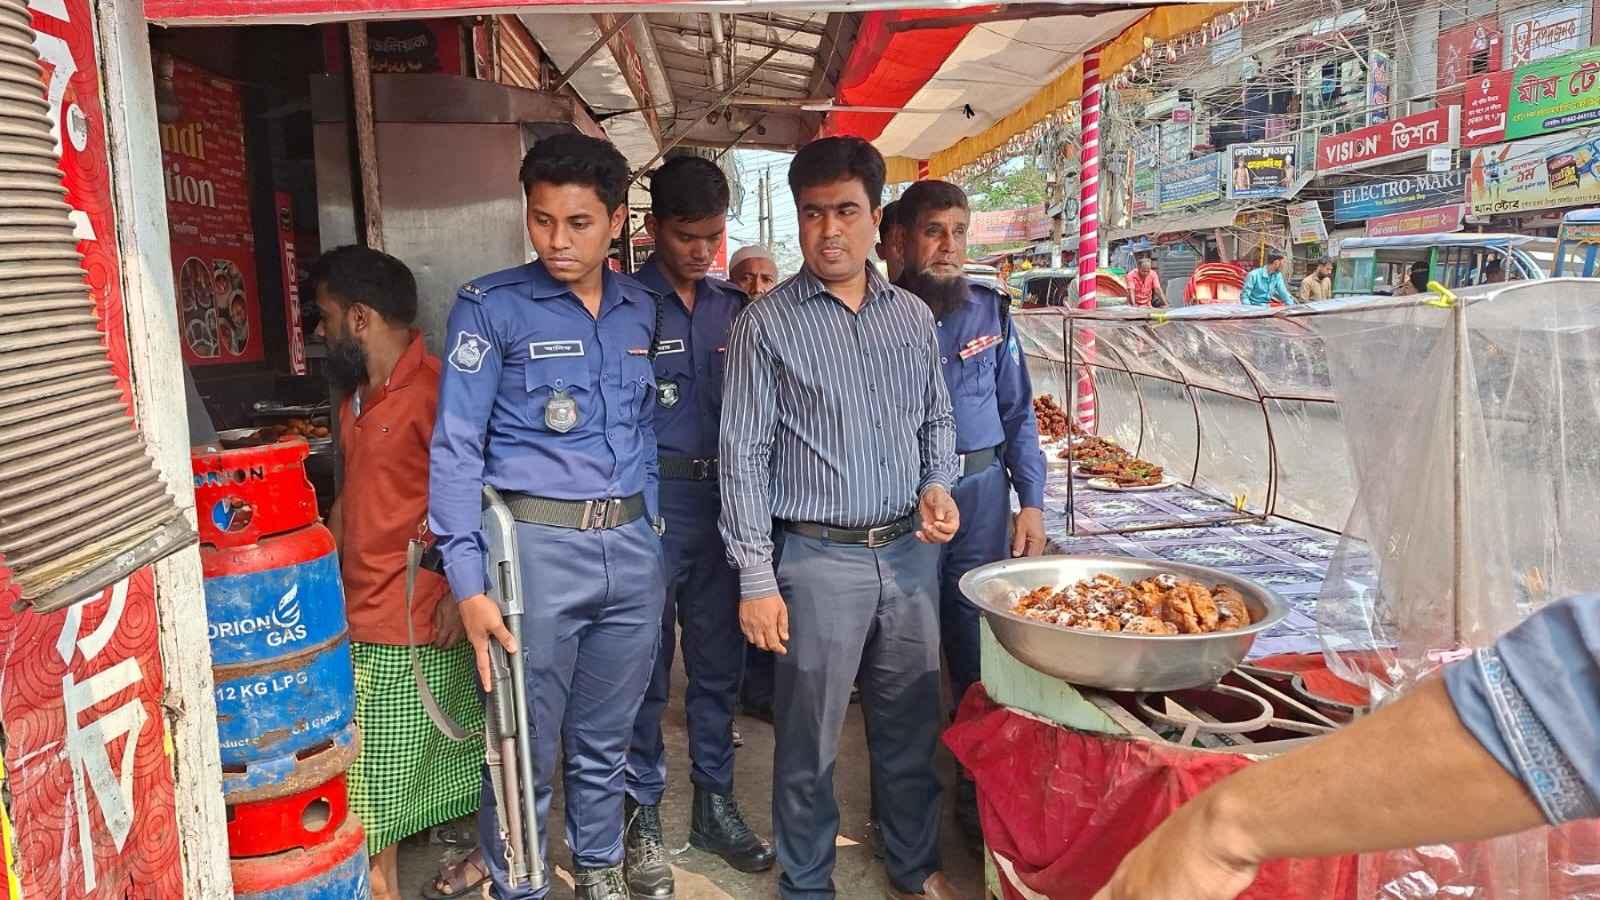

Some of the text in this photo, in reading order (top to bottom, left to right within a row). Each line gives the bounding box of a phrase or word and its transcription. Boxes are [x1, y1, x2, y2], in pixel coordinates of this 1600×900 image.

[1326, 134, 1378, 163] VISION
[1390, 120, 1440, 151] ভিশন
[165, 162, 216, 208] tion
[1343, 169, 1465, 205] ELECTRO-MART
[208, 615, 271, 640] ORION
[267, 624, 307, 647] GAS
[216, 671, 308, 701] 12 KG LPG
